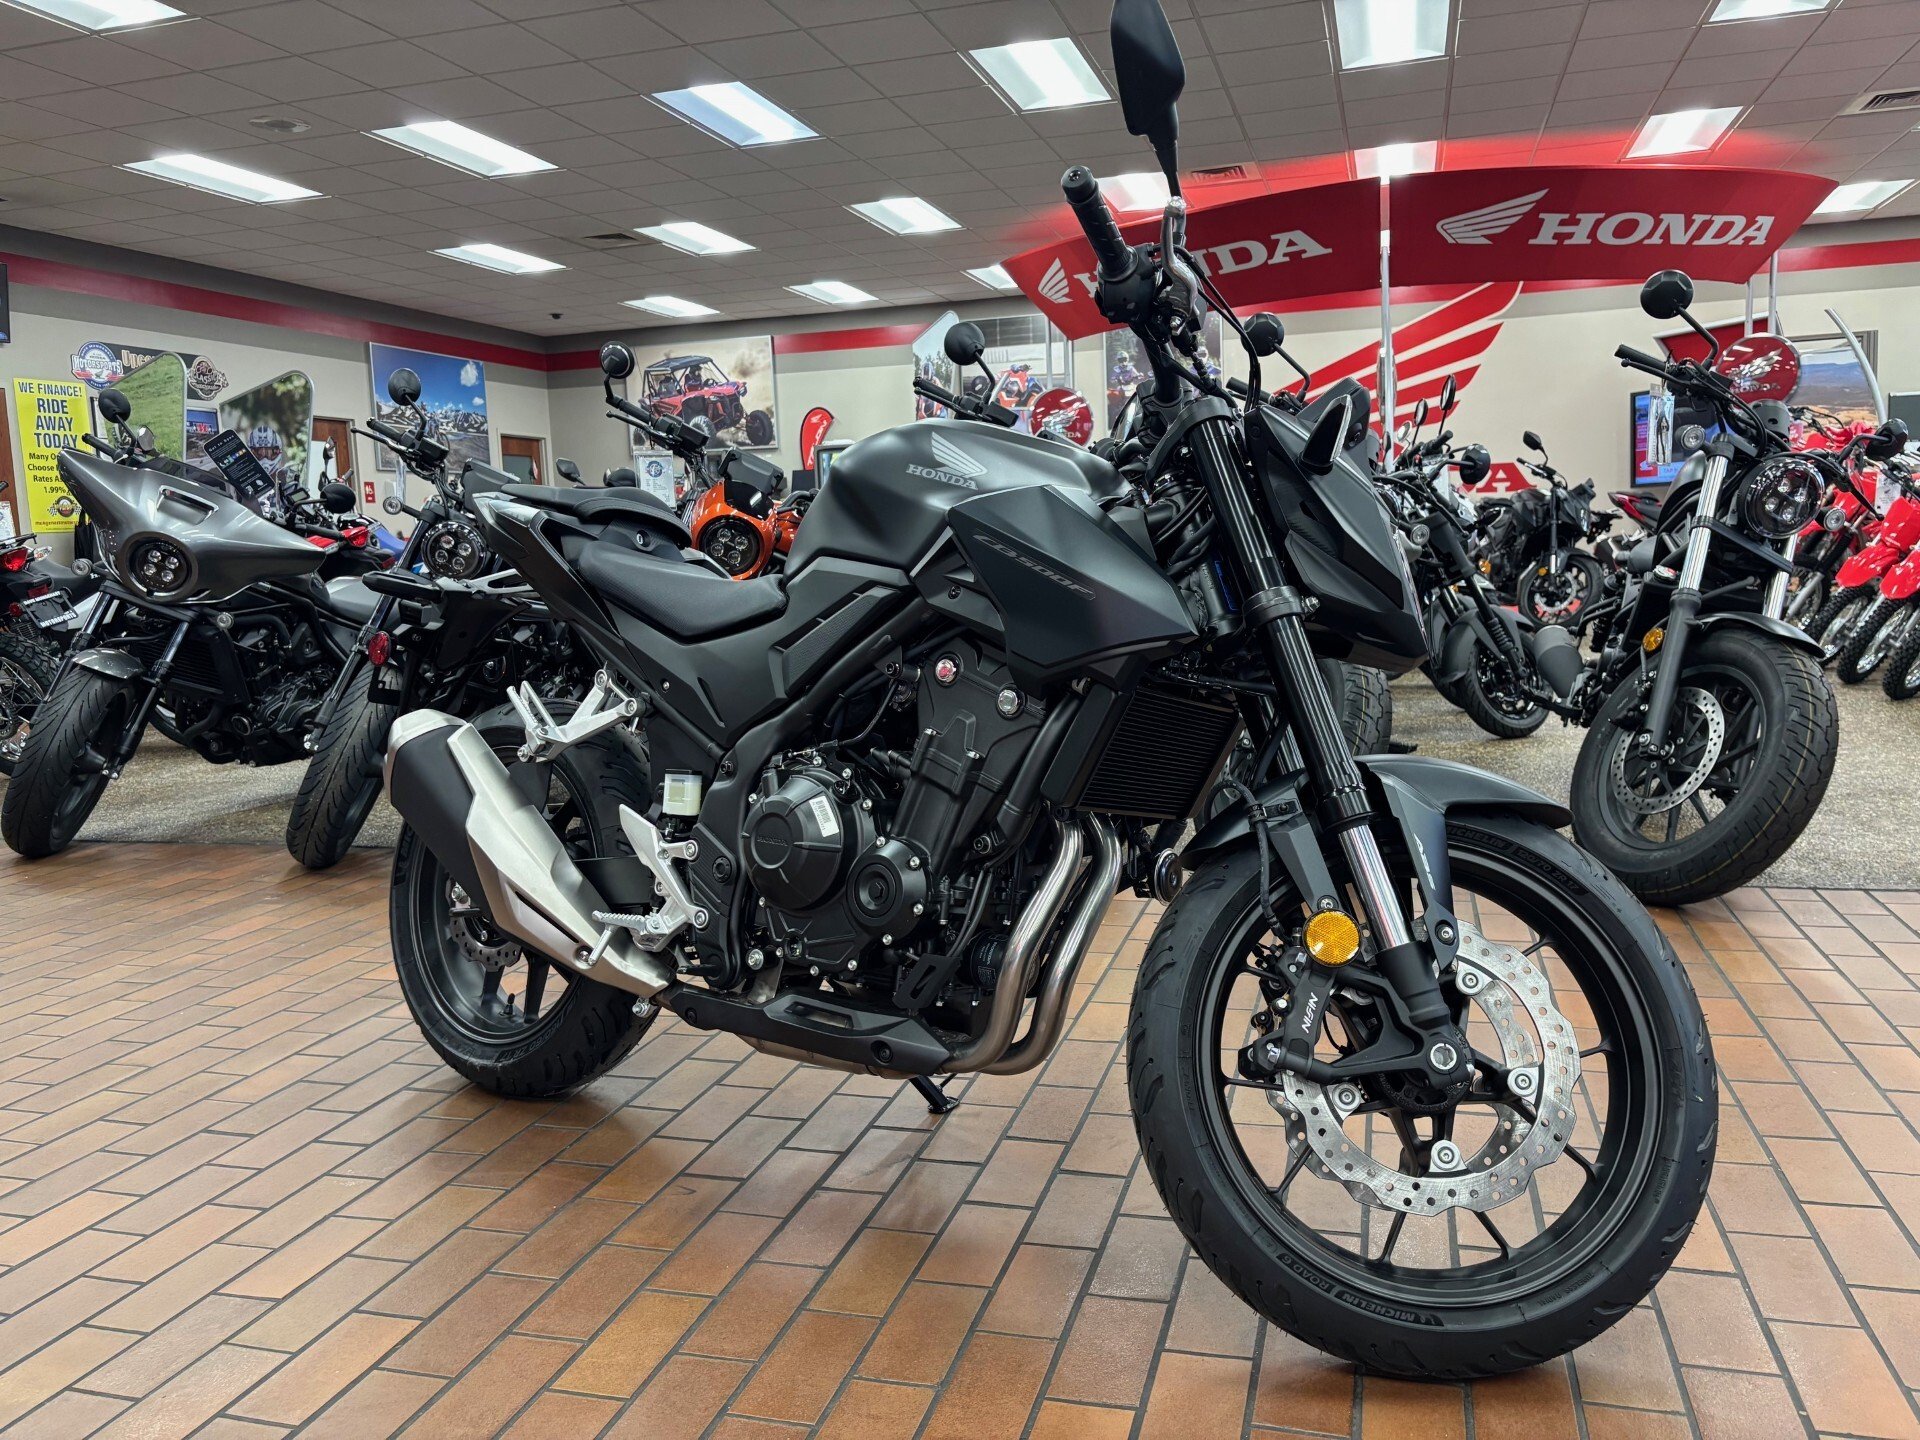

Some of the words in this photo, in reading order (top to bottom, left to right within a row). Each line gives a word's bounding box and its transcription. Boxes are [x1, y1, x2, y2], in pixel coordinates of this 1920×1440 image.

[1527, 211, 1776, 246] HONDA
[72, 355, 122, 375] MOTORSPORTS
[18, 382, 35, 394] WE
[37, 382, 82, 397] FINANCE!
[36, 398, 69, 414] RIDE
[36, 415, 73, 431] AWAY
[34, 432, 78, 448] TODAY
[28, 453, 49, 462] Many
[27, 463, 55, 472] Choose
[33, 475, 54, 483] Rates
[906, 463, 978, 490] HONDA
[43, 486, 67, 494] 1.99%
[973, 534, 1095, 598] CB500F
[40, 611, 77, 628] MOTORSPORTS
[1413, 832, 1436, 891] ABS
[1301, 991, 1319, 1034] NISSIN
[1293, 1263, 1330, 1291] ROAD
[1341, 1290, 1416, 1323] MICHELIN
